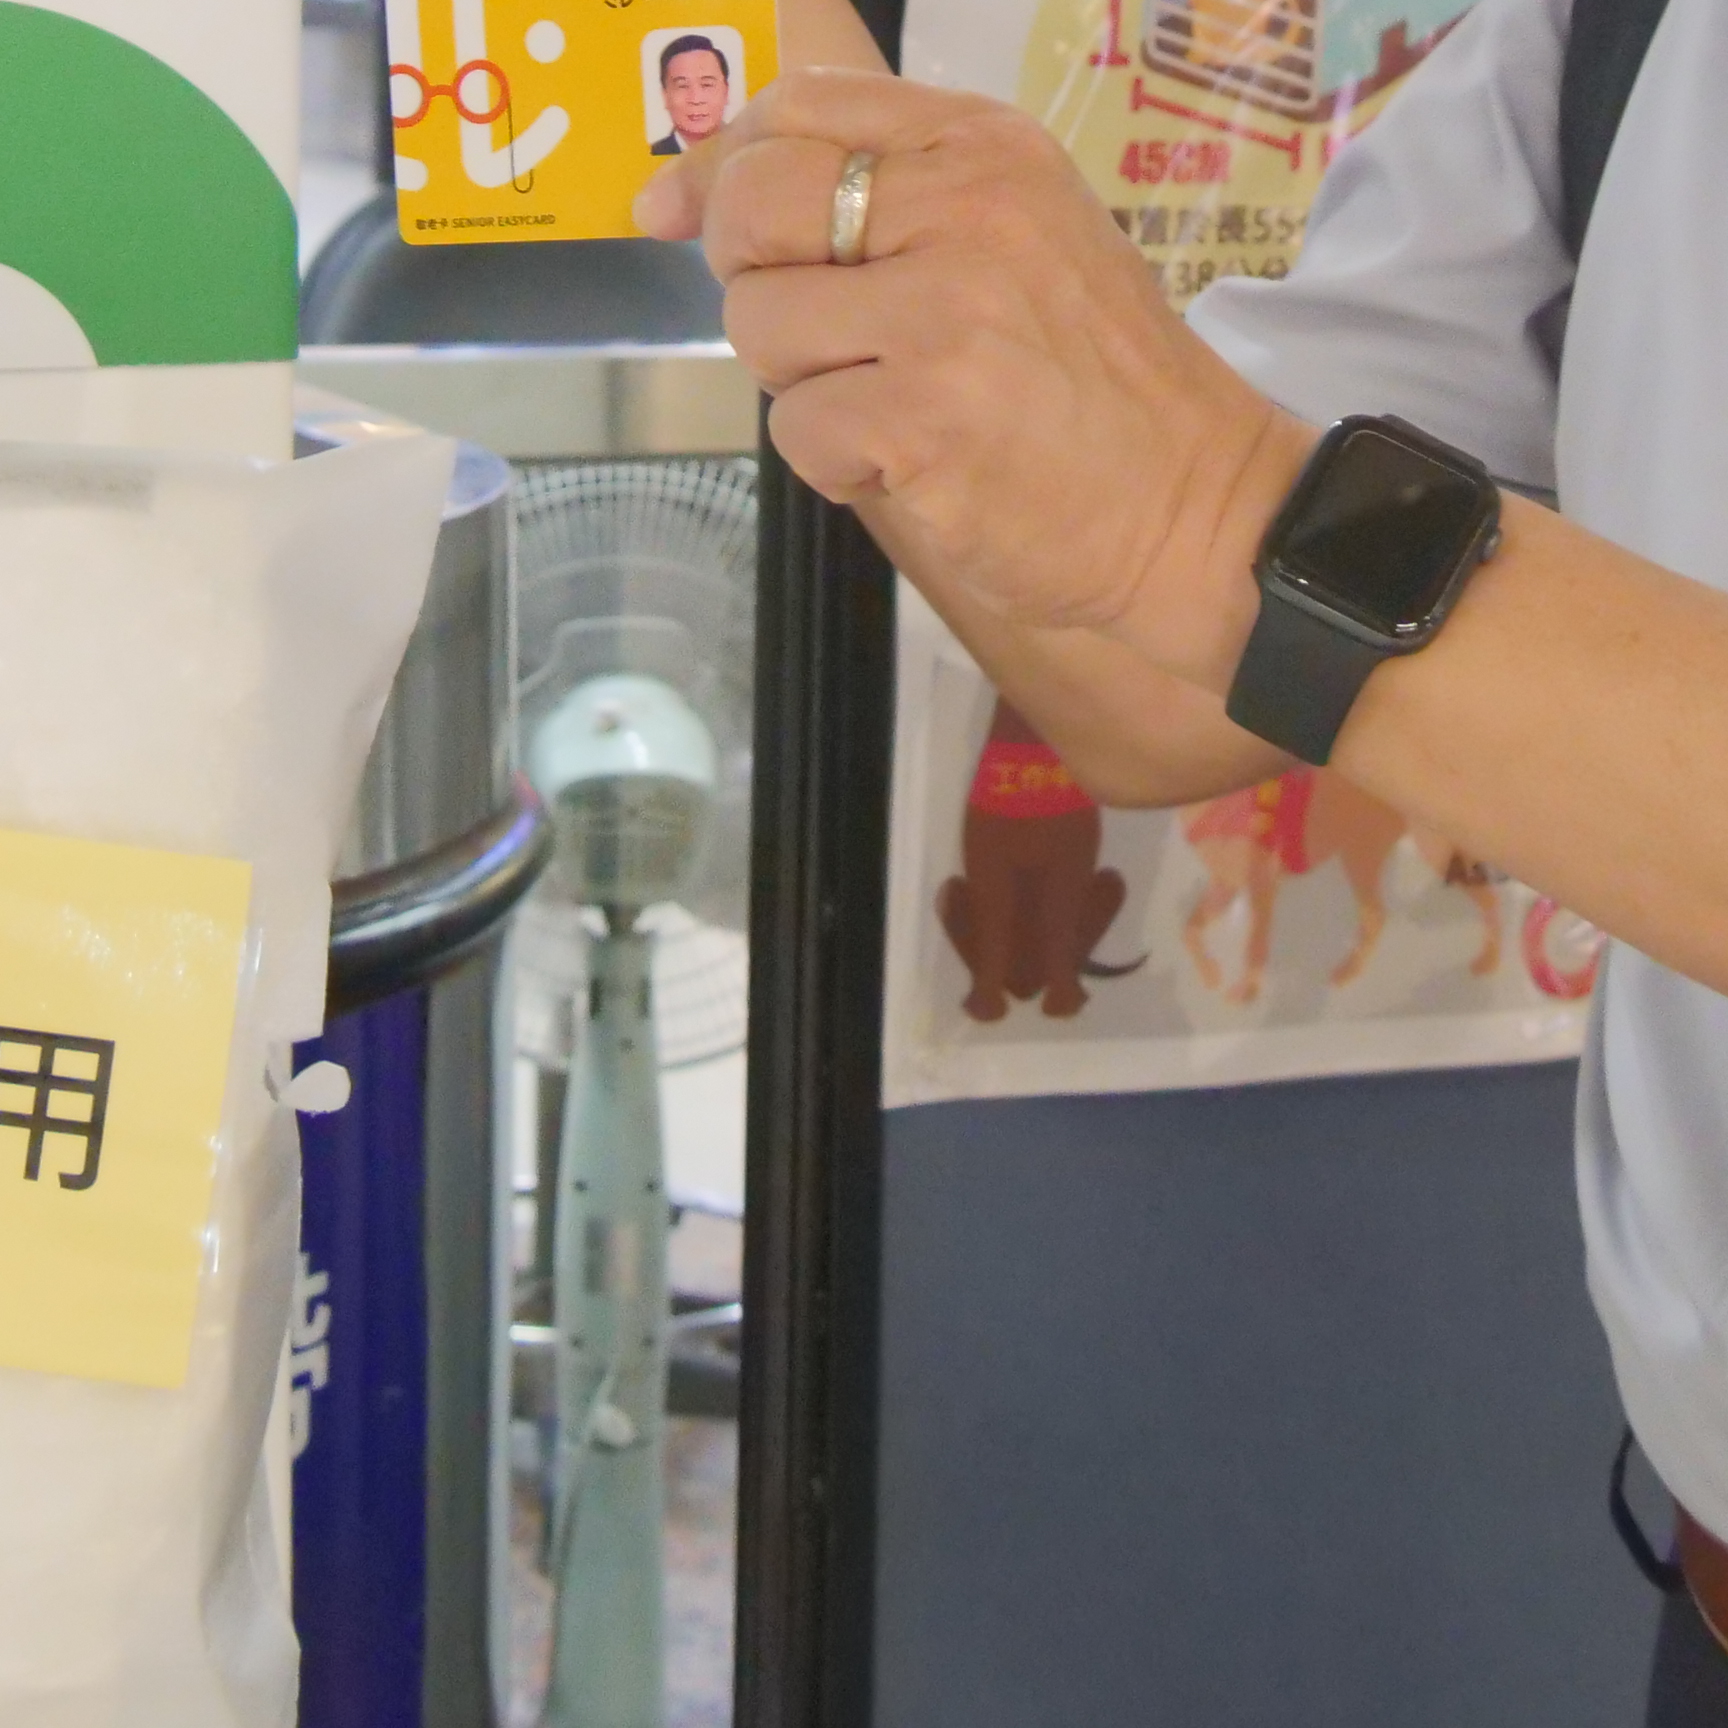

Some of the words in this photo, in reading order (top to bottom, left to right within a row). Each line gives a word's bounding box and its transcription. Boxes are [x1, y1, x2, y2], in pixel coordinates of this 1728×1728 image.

[1119, 140, 1232, 186] 45CM
[452, 216, 496, 229] SENIOR
[497, 213, 557, 228] EASYCARD
